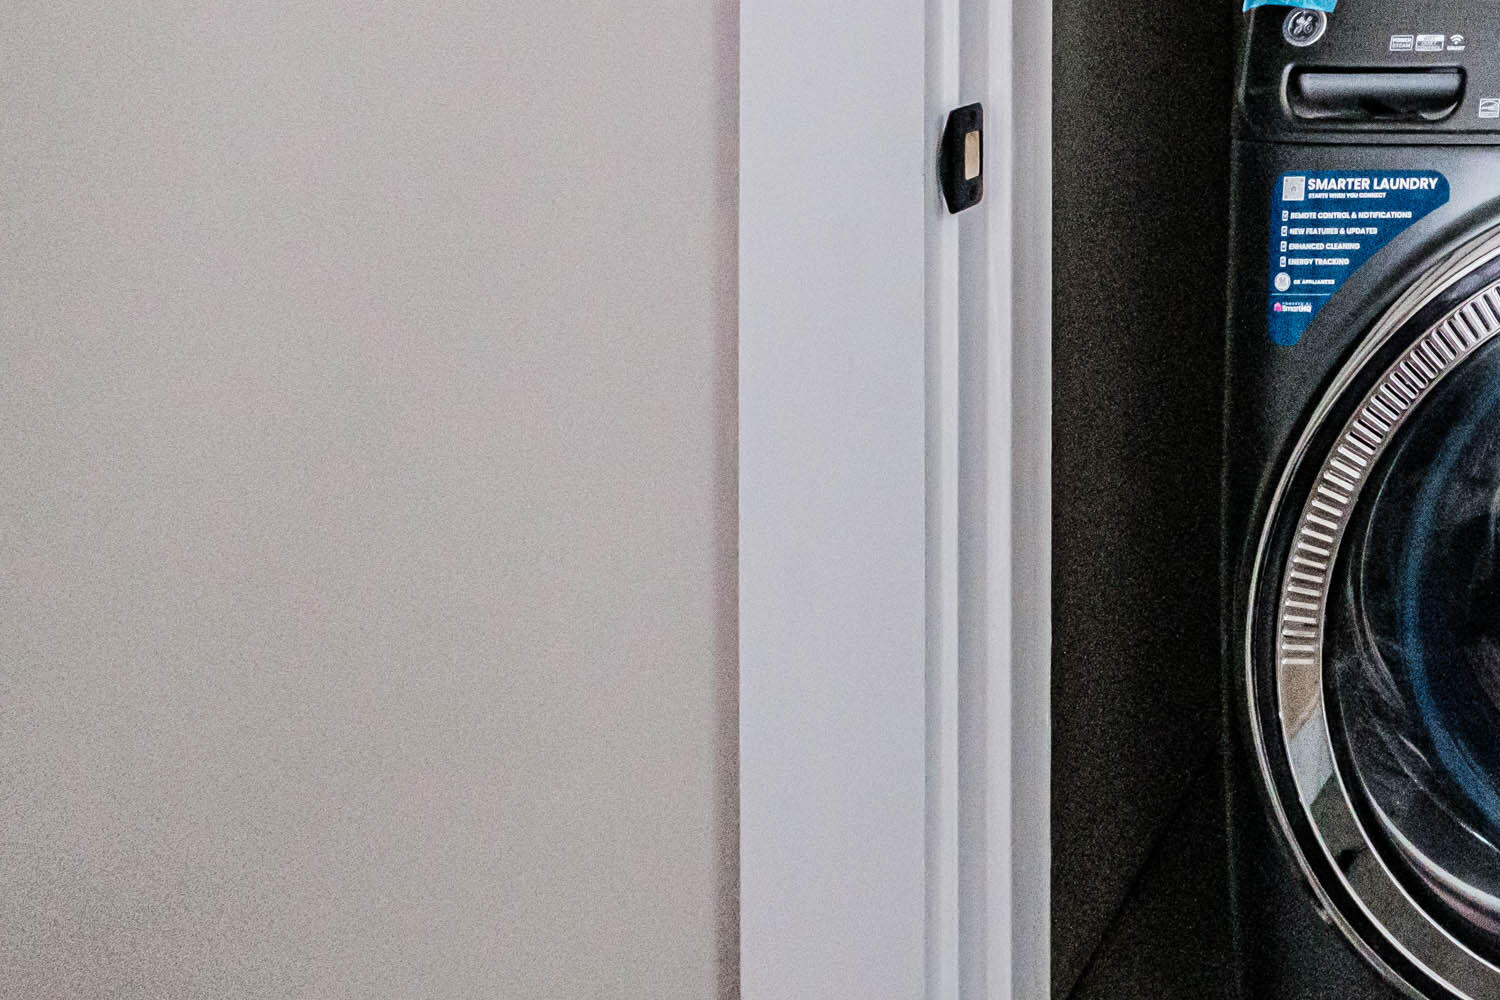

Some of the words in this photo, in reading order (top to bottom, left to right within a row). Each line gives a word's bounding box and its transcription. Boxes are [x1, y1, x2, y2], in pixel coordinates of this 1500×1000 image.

[1307, 178, 1370, 190] SMARTER
[1373, 177, 1439, 190] LAUNDRY
[1351, 211, 1357, 219] &
[1358, 211, 1412, 219] NOTIFICATIONS
[1346, 227, 1378, 235] UPDATES
